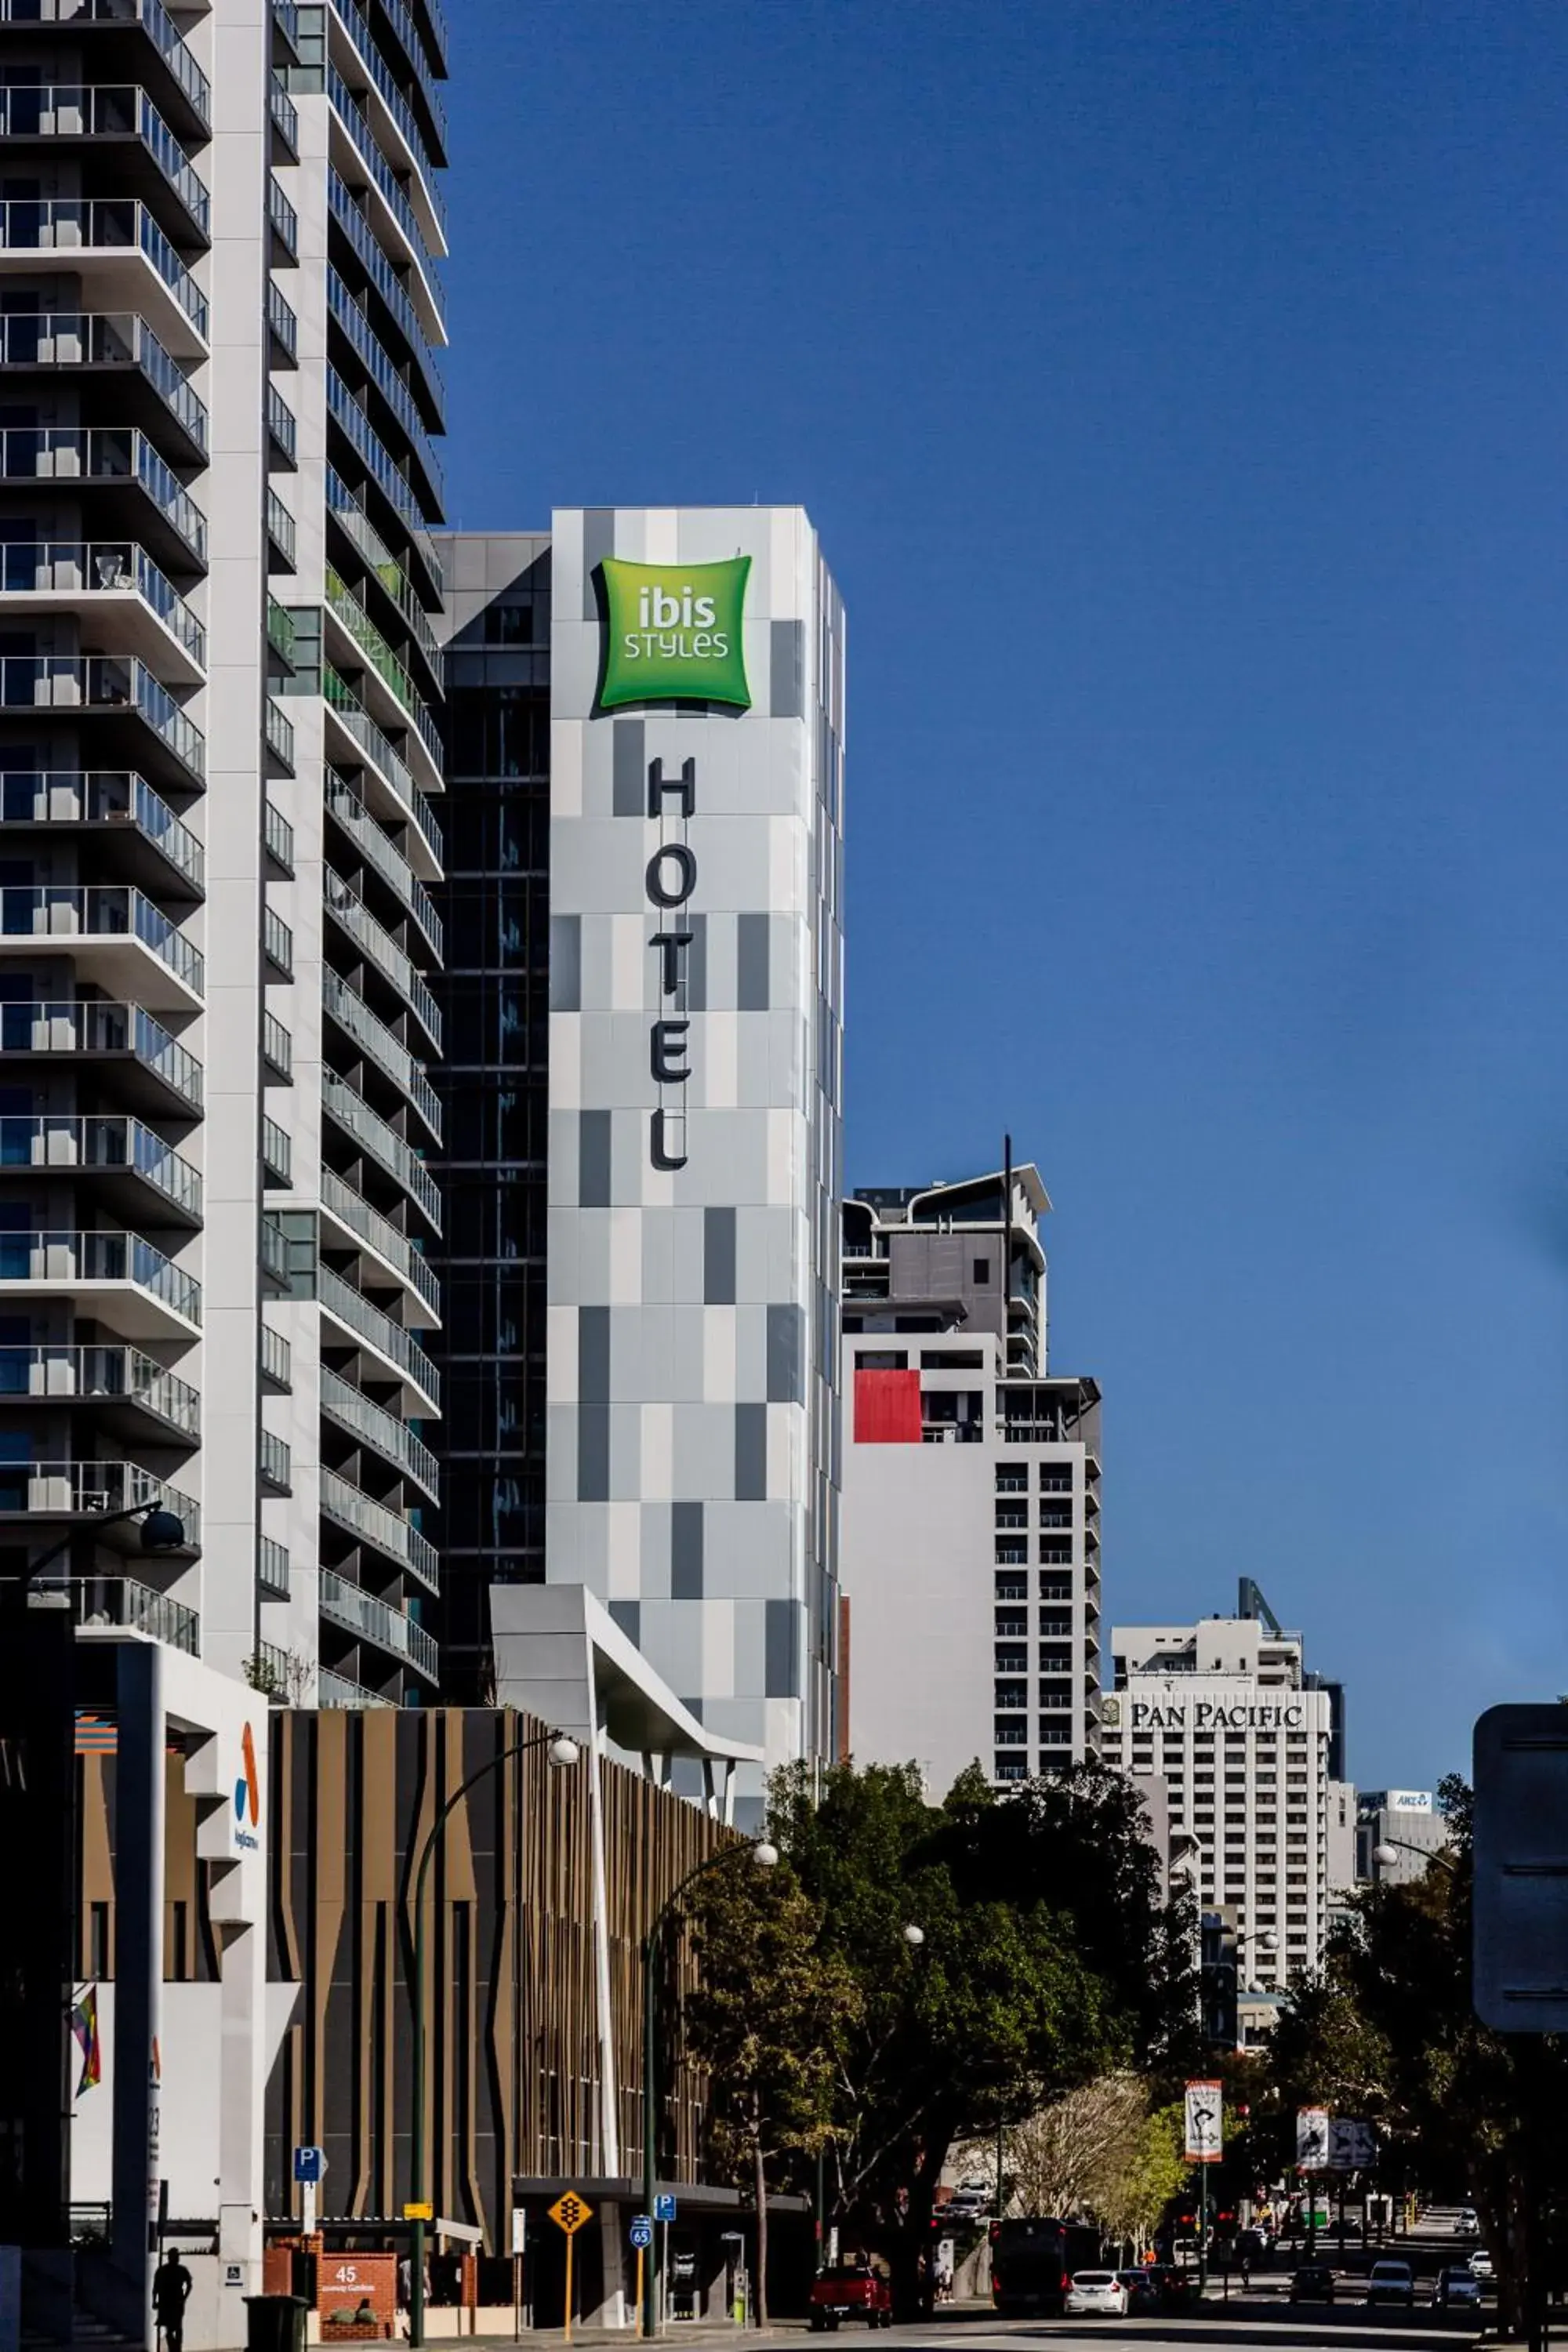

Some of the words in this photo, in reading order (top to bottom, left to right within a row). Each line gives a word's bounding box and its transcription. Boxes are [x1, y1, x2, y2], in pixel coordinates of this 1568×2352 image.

[639, 586, 716, 628] ibis
[646, 757, 697, 1171] HOTEL
[1131, 1702, 1186, 1727] PAN
[1192, 1702, 1302, 1728] PACIFIC
[301, 2149, 314, 2166] P
[661, 2196, 672, 2209] P
[634, 2230, 648, 2243] 65
[336, 2266, 357, 2282] 45
